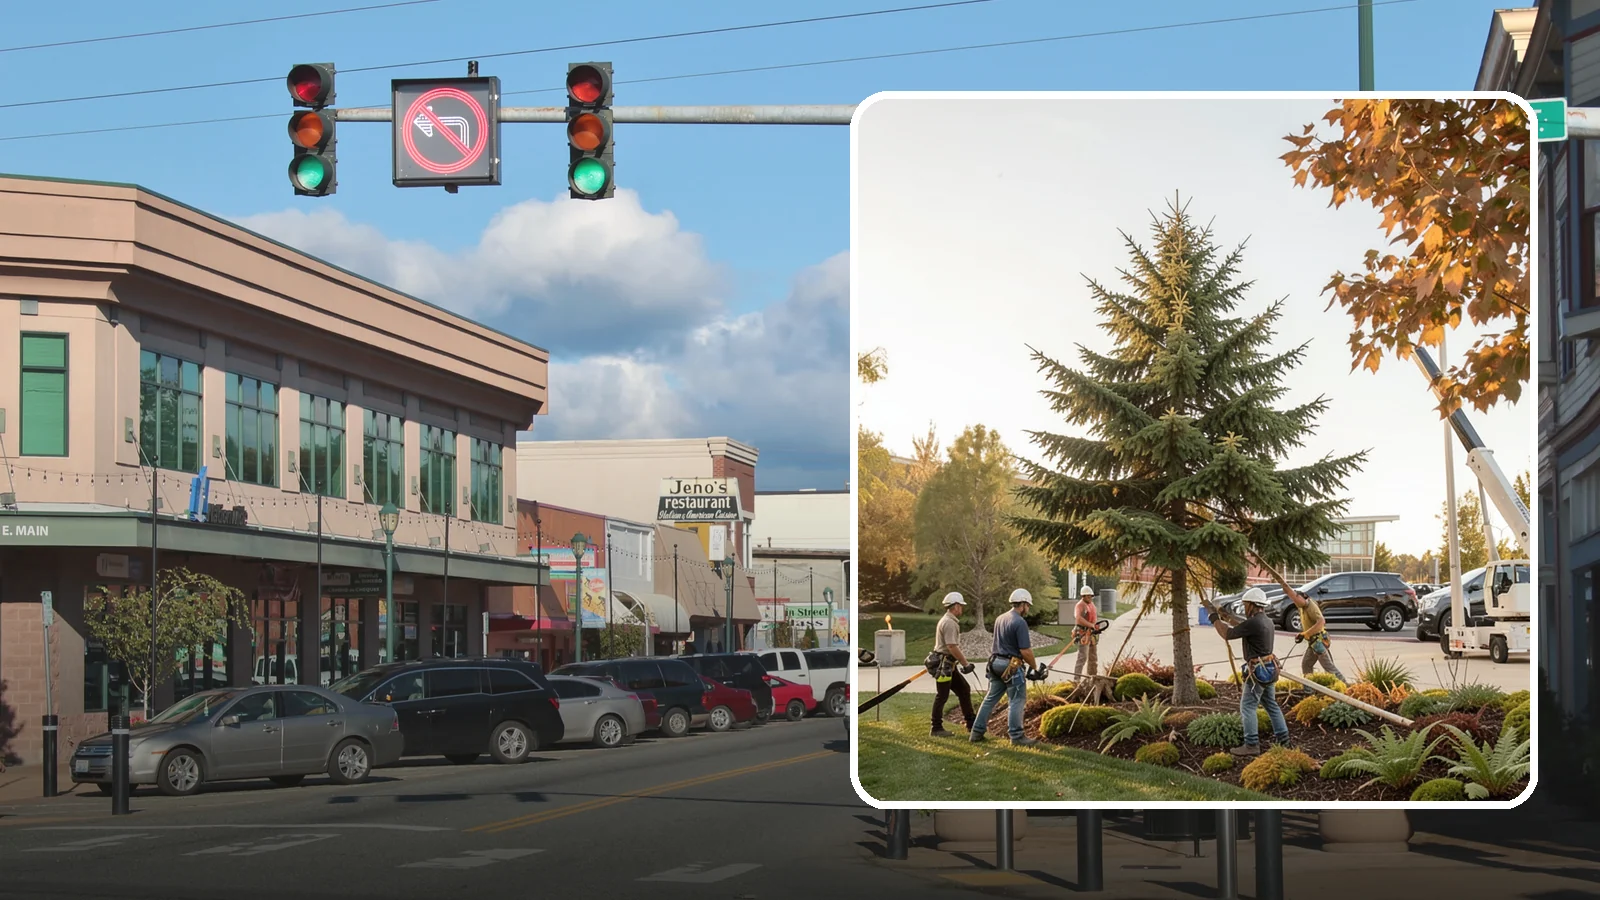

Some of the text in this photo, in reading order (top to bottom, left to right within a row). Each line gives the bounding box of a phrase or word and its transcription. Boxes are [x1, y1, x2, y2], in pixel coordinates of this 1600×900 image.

[670, 480, 727, 494] Jeno's
[665, 496, 731, 509] restaurant
[659, 510, 682, 519] Italian
[686, 510, 714, 519] American
[715, 509, 738, 519] Cuisine
[2, 525, 49, 536] E. MAIN
[797, 607, 829, 617] Street
